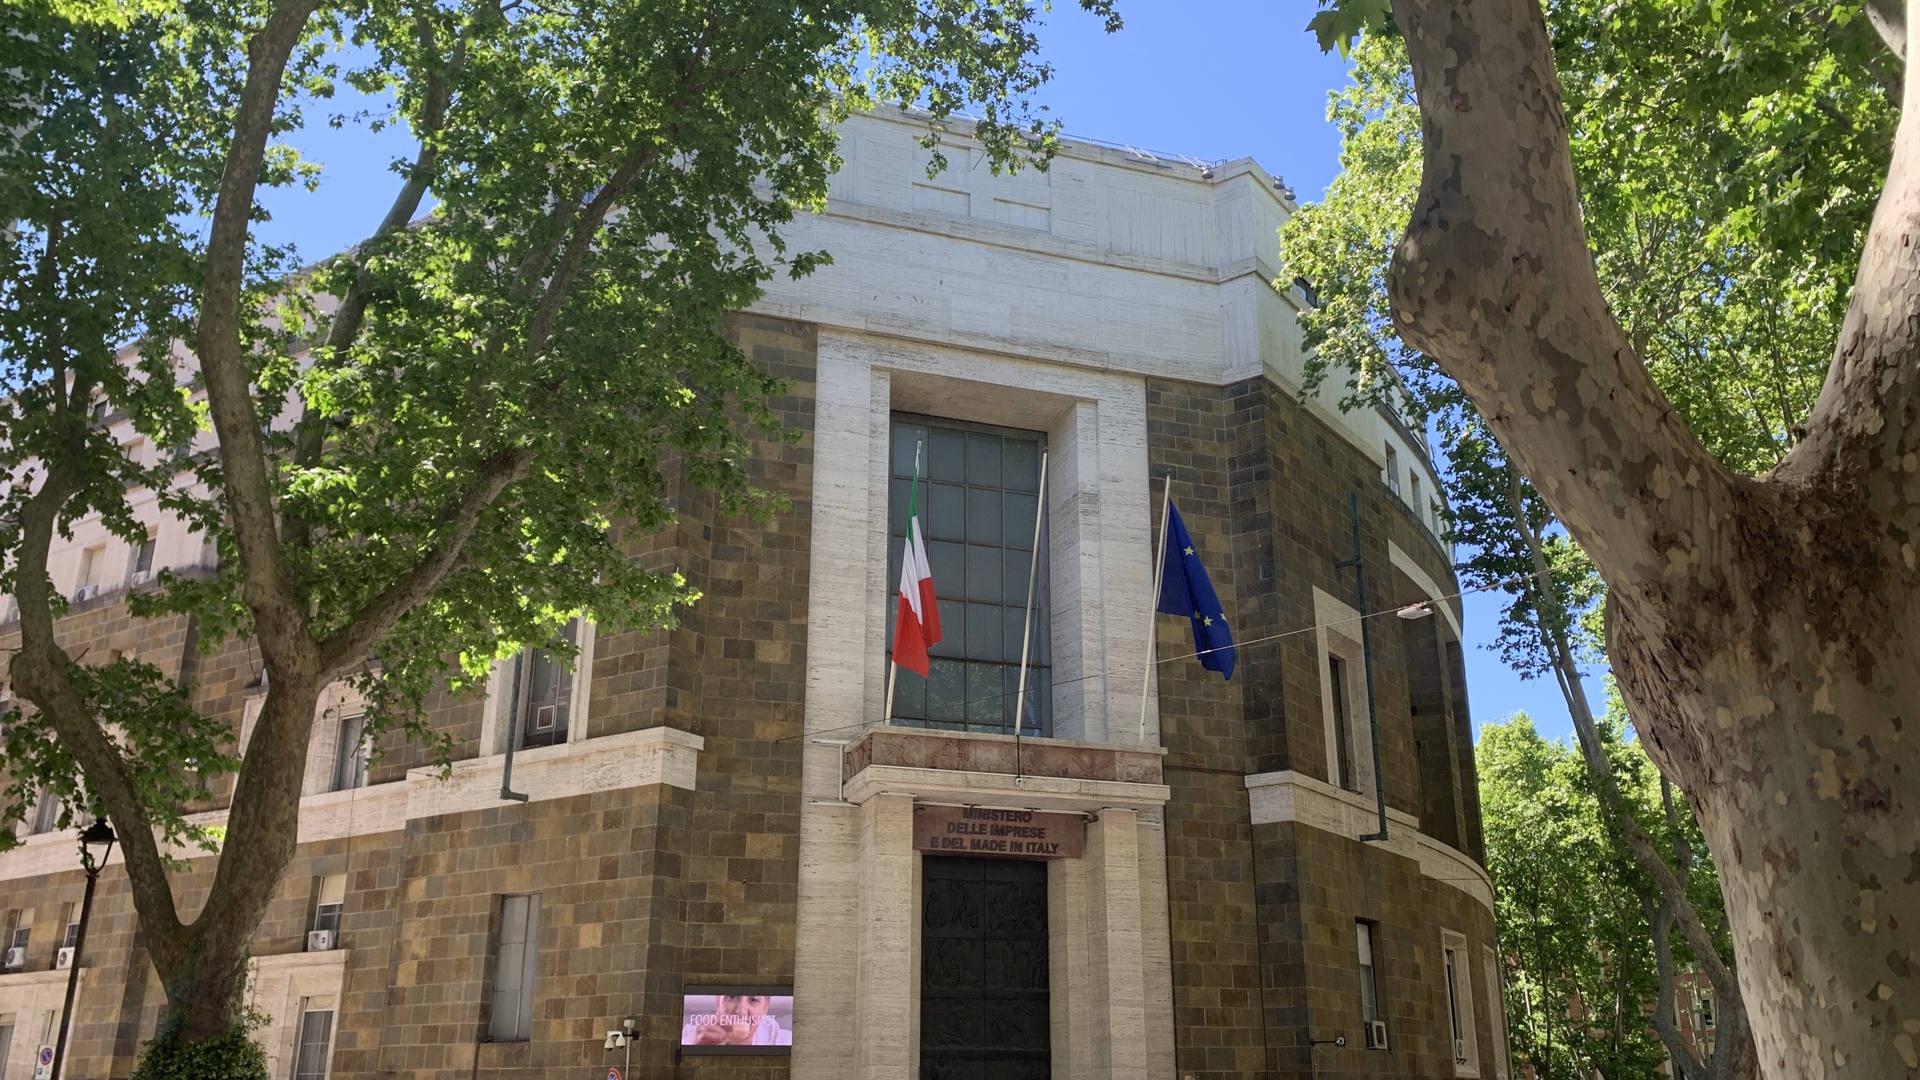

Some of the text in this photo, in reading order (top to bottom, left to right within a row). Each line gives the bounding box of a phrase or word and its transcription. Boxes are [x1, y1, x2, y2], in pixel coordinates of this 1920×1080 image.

[962, 807, 1032, 823] MINISTERO
[947, 821, 1046, 839] DELLE IMPRESE
[930, 836, 1059, 855] E DEL MADE IN ITALY
[690, 1014, 777, 1026] FOOD ENTHUSIAST
